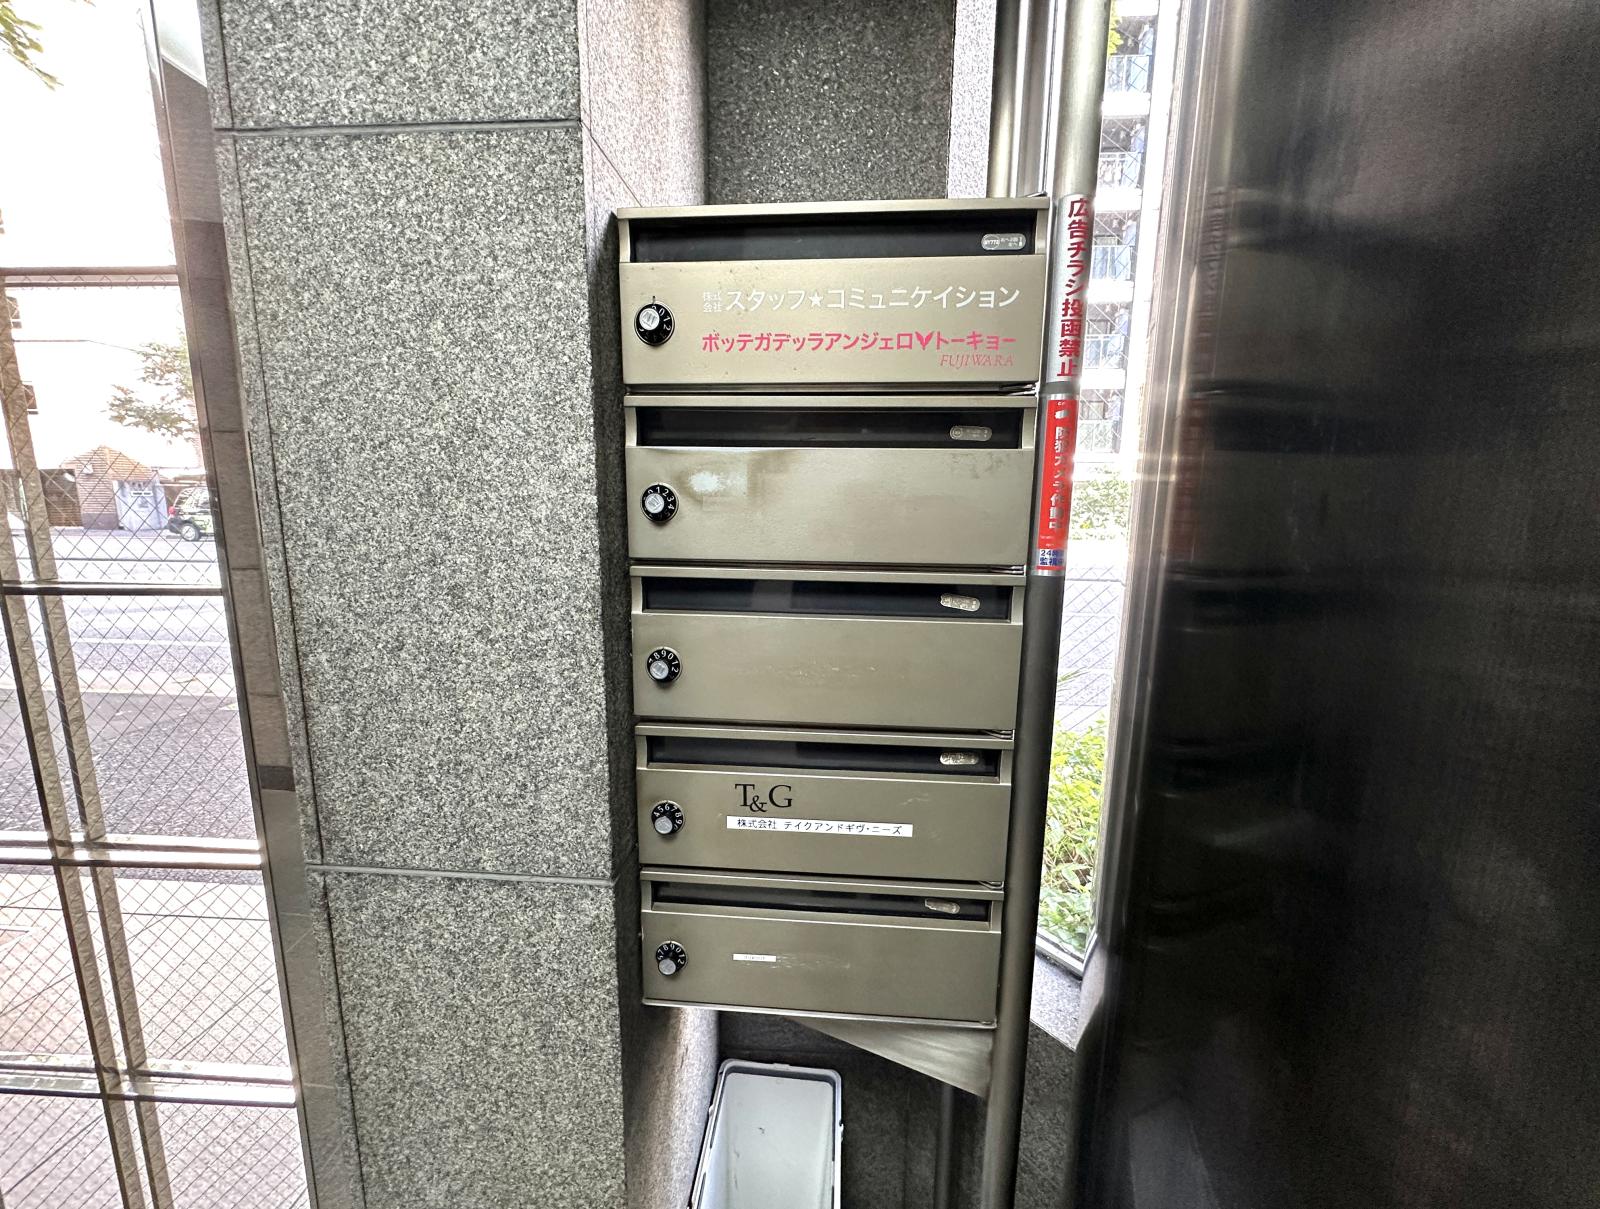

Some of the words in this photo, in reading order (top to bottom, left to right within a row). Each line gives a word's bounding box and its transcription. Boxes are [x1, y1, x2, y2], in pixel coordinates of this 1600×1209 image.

[1057, 198, 1089, 377] 広告チラシ投函禁止
[940, 354, 1014, 369] FUJIWARA
[735, 784, 793, 812] T&G
[737, 819, 776, 829] 株式会社
